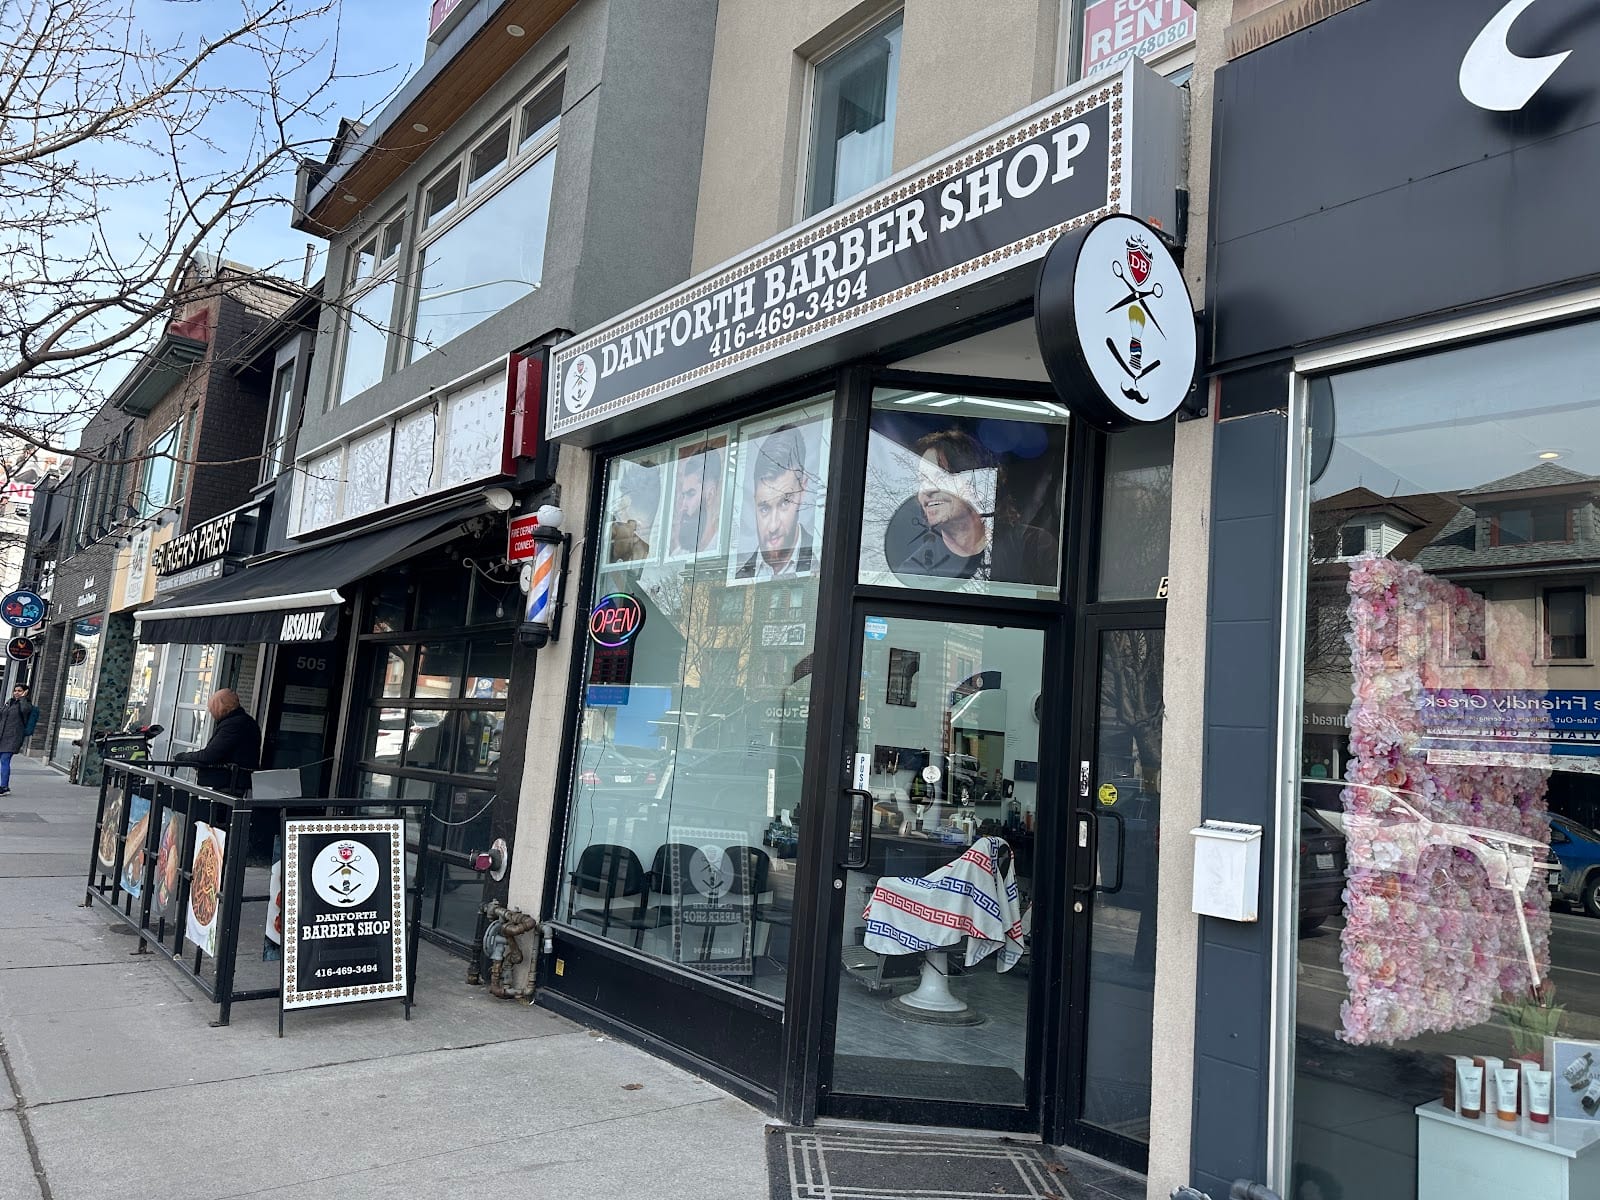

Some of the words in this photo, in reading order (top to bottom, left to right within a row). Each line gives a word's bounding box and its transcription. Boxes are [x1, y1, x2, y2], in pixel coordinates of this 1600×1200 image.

[1090, 0, 1183, 63] RENT
[601, 277, 756, 379] DANFORTH
[764, 199, 928, 310] BARBER
[940, 121, 1091, 233] SHOP
[1130, 254, 1148, 273] DB
[709, 270, 868, 358] 416-469-3494
[156, 529, 198, 576] BURGER'S
[197, 512, 237, 562] PRIEST
[592, 607, 637, 633] OPEN
[296, 656, 326, 671] 505
[858, 756, 866, 790] PUSH
[315, 911, 378, 923] DANFORTH
[302, 922, 356, 941] BARBER
[357, 920, 391, 937] SHOP
[314, 963, 378, 978] 416-469-3494
